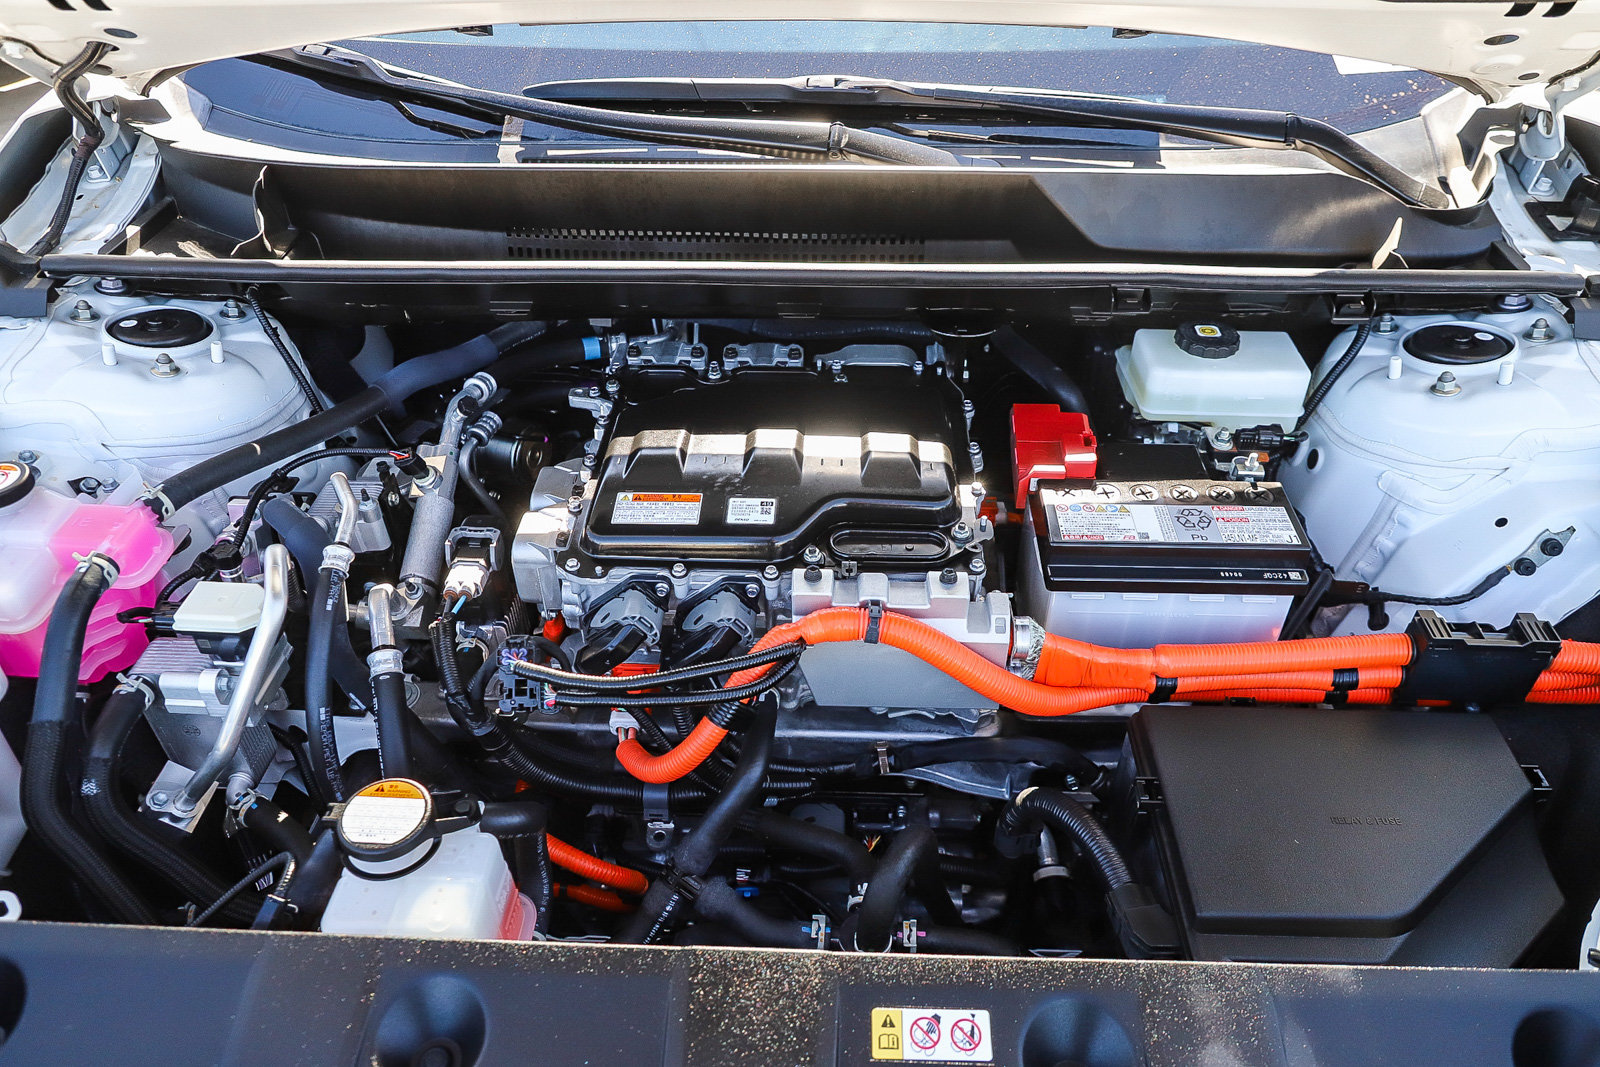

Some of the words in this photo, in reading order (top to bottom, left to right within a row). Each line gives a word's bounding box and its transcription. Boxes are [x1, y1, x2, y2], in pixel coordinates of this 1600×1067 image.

[1286, 535, 1300, 544] J1
[1329, 816, 1363, 825] RELAY
[1365, 816, 1374, 825] &
[1374, 816, 1403, 825] FUSE
